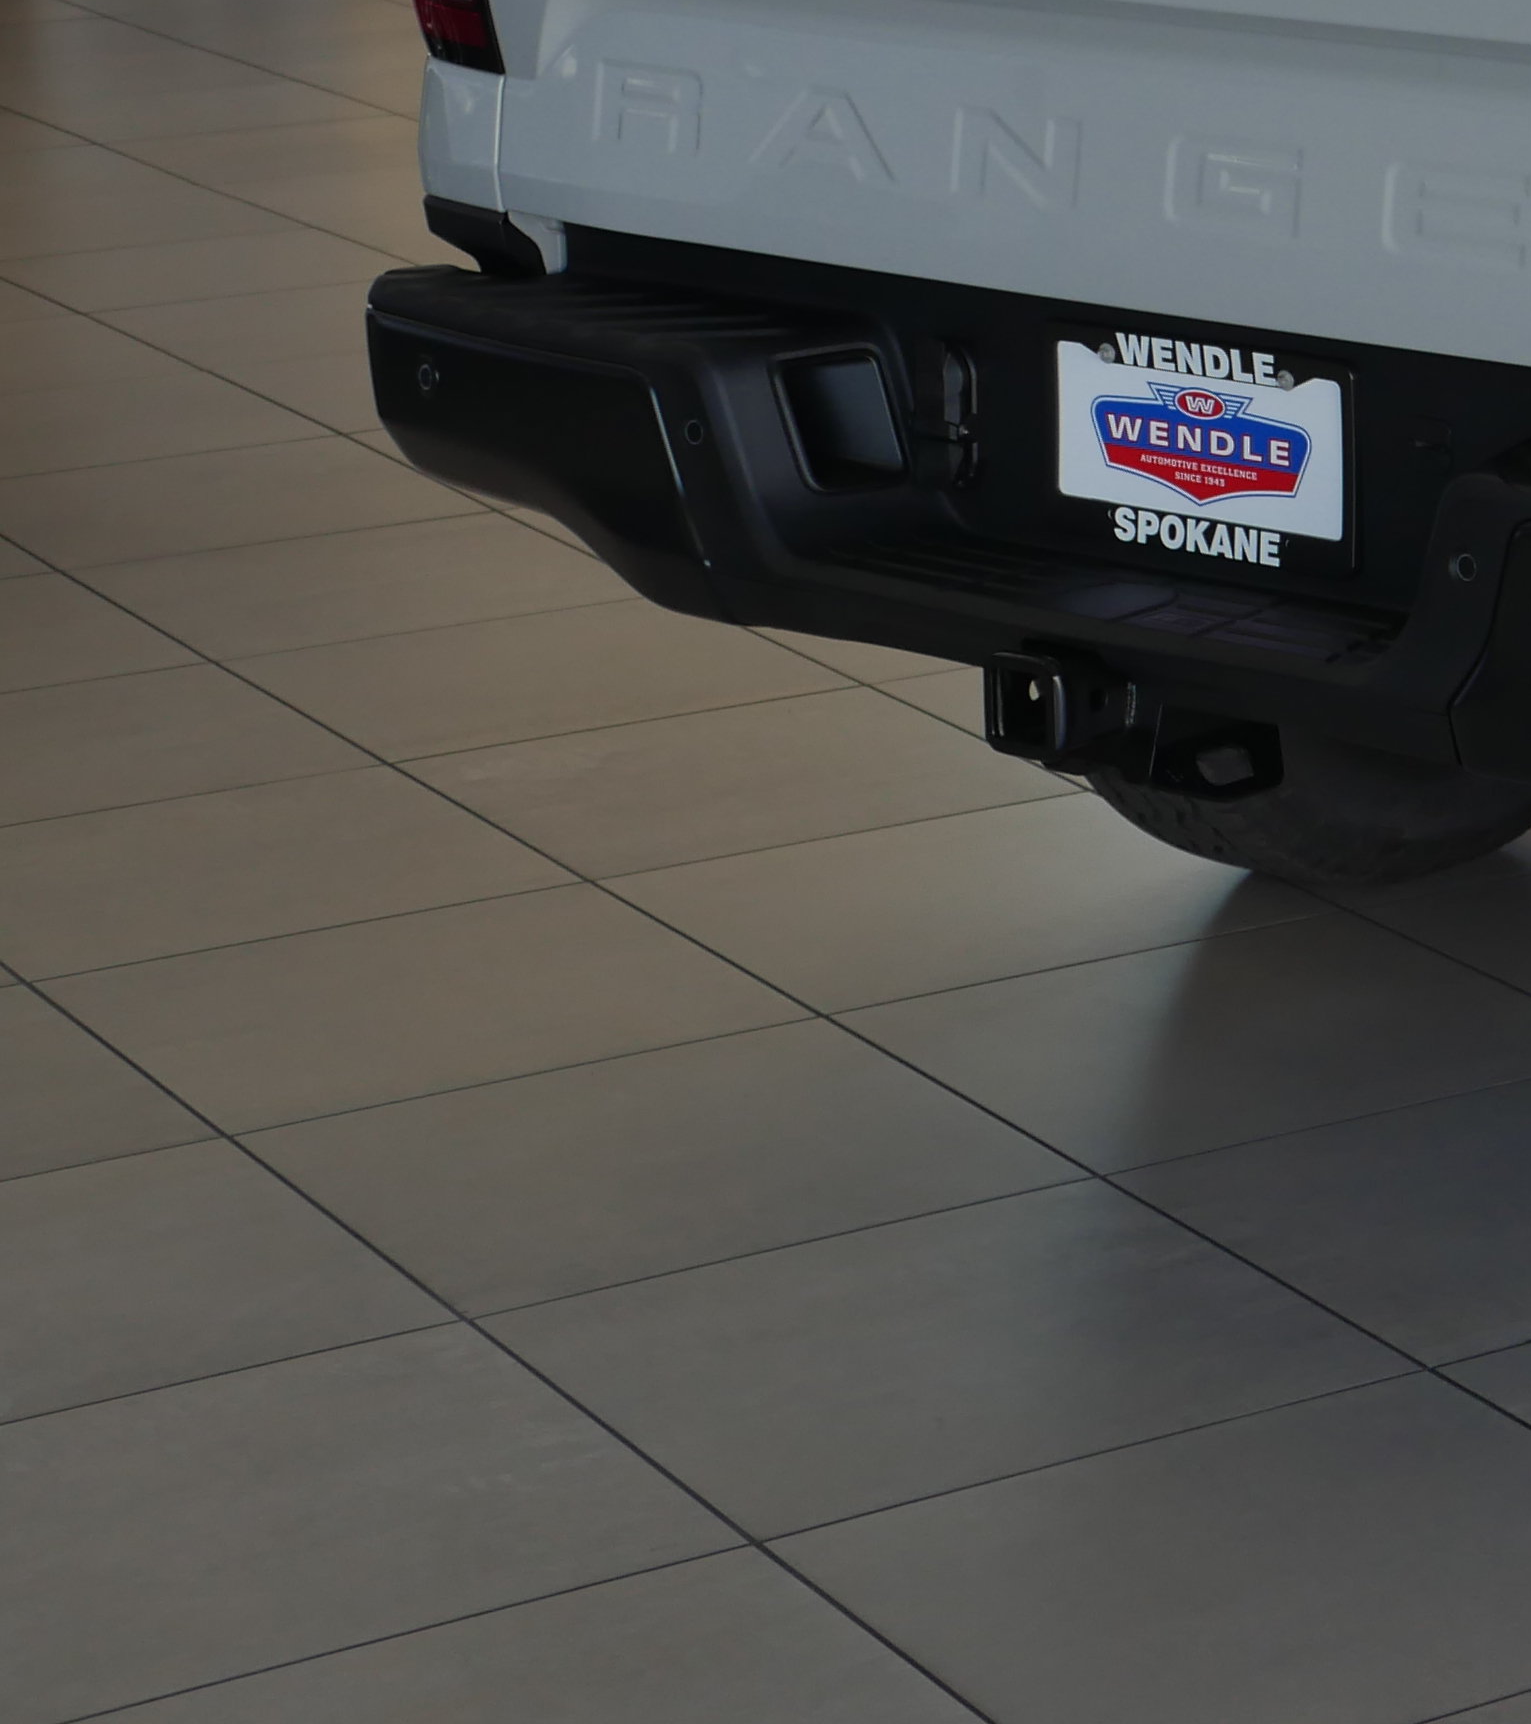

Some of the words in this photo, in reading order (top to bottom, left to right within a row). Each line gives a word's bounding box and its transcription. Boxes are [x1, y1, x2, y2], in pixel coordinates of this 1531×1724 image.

[1115, 332, 1279, 387] WENDLE
[1185, 395, 1215, 415] W
[1106, 413, 1290, 467] WENDLE
[1140, 454, 1198, 471] AUTOMOTIVE
[1200, 463, 1257, 481] EXCELLENCE
[1174, 471, 1201, 484] SINCE
[1113, 507, 1281, 567] SPOKANE
